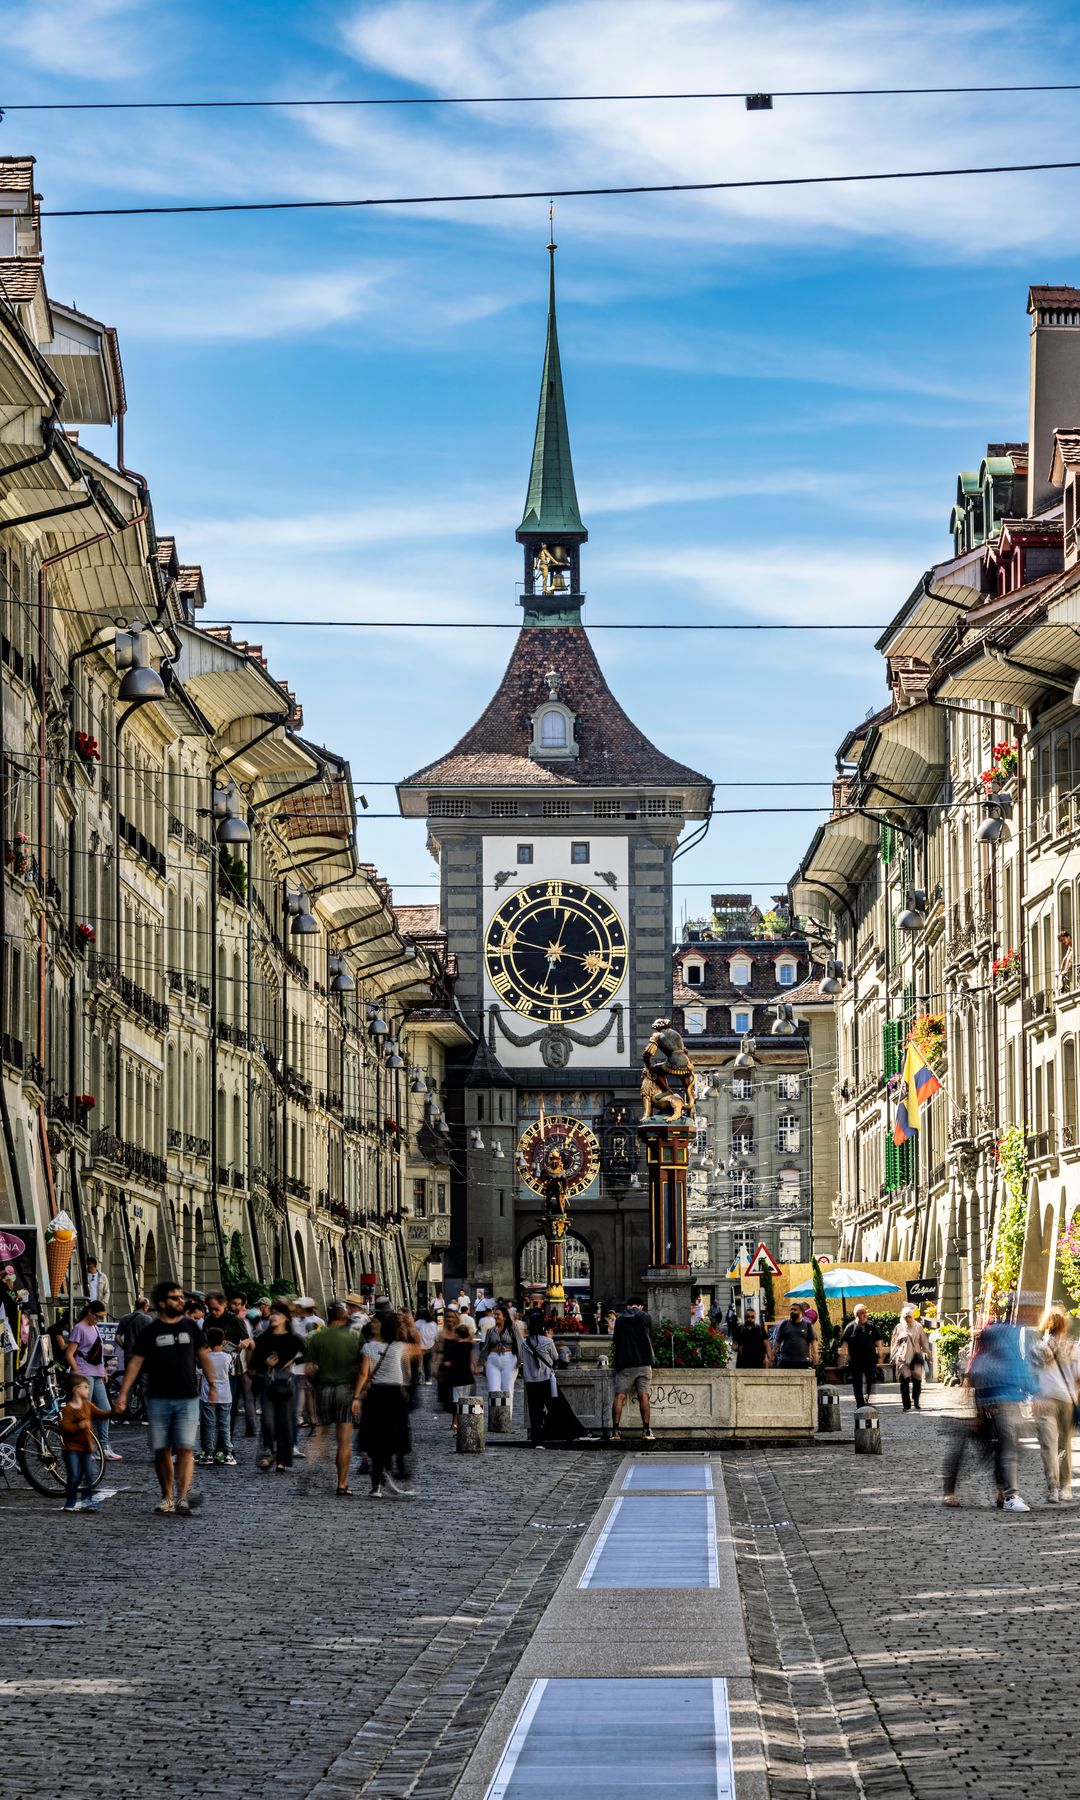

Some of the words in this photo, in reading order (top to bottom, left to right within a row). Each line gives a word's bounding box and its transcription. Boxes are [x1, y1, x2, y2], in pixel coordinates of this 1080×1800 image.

[546, 882, 562, 896] XII
[517, 891, 531, 907] XI
[582, 891, 591, 904] I
[495, 914, 508, 929] X
[603, 913, 617, 927] II
[612, 945, 626, 958] III
[601, 974, 620, 993] IIII
